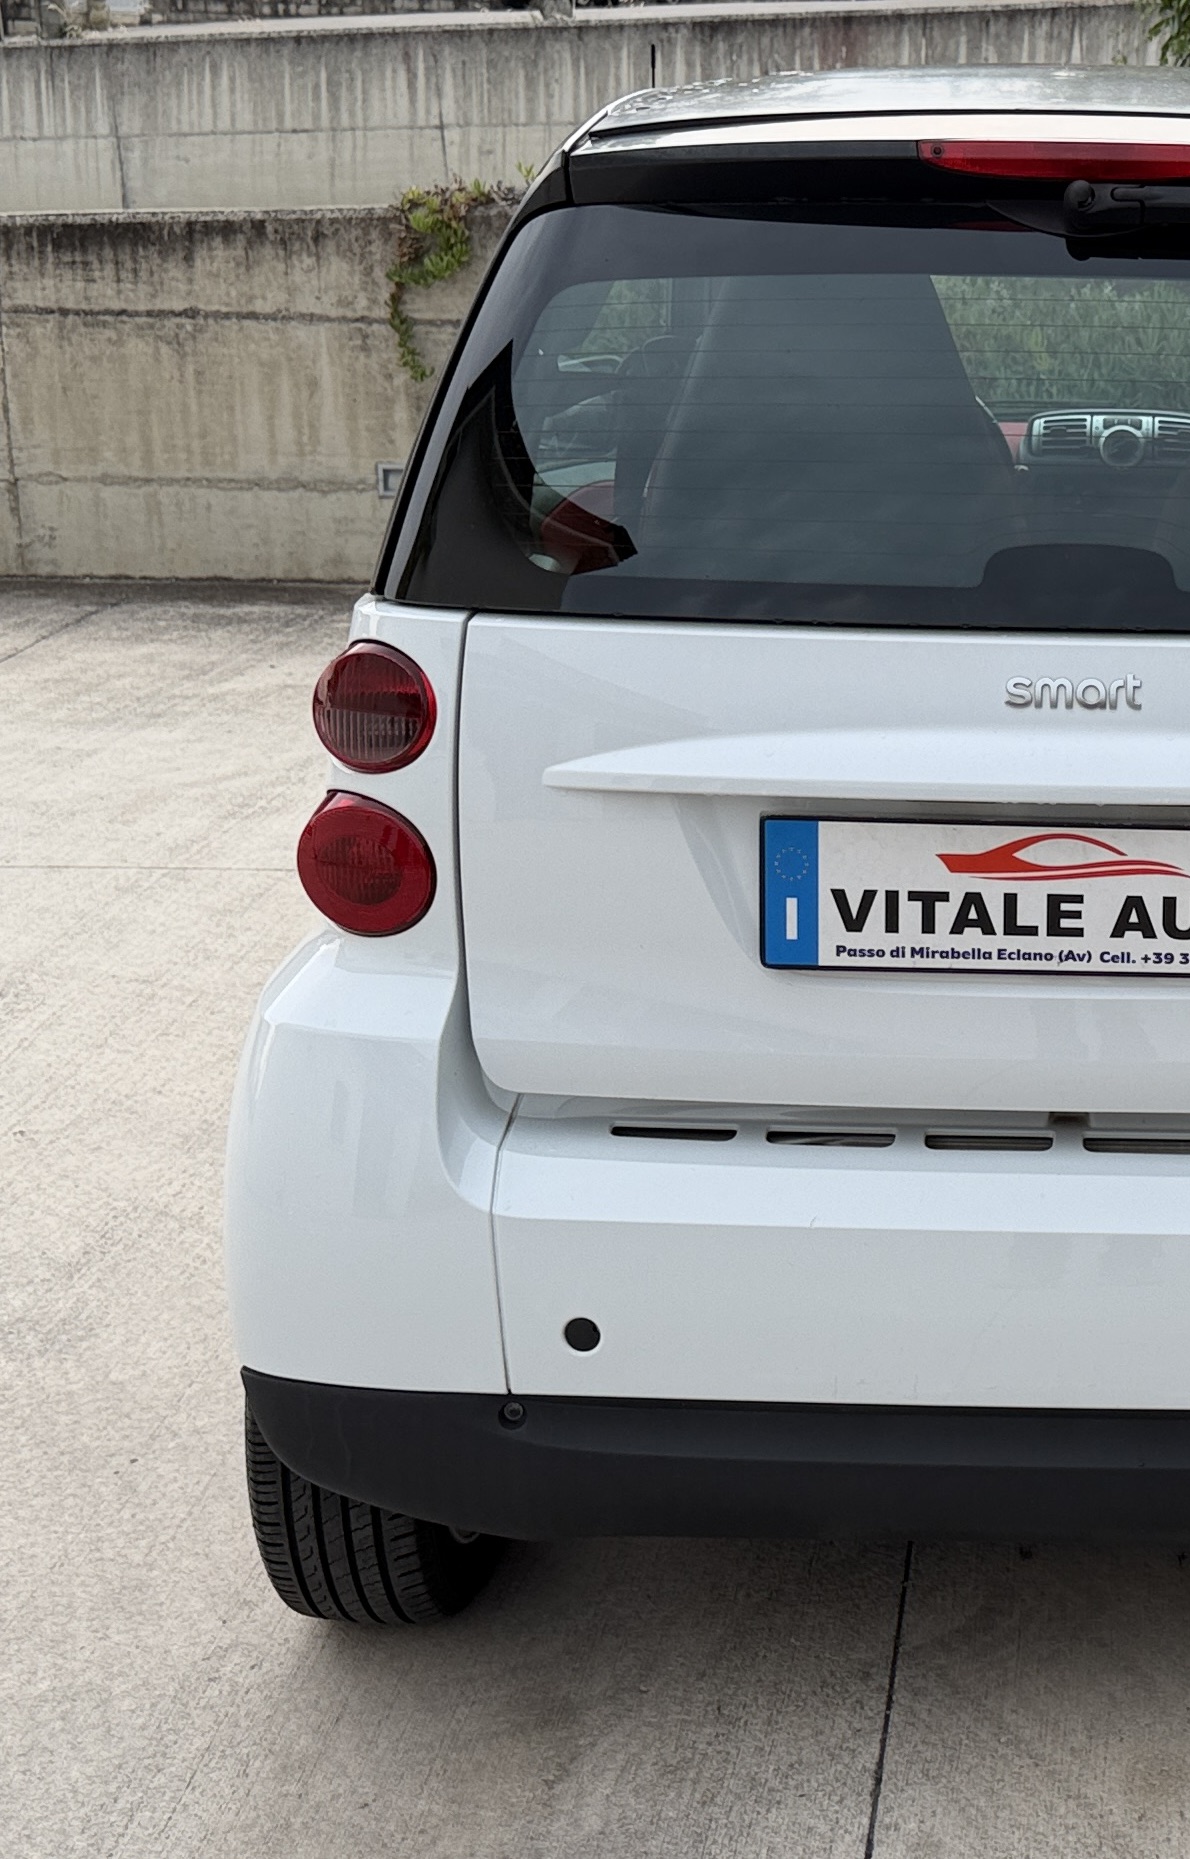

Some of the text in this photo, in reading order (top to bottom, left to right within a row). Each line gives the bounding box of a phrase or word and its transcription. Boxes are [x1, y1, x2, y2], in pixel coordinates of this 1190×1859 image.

[1004, 674, 1142, 711] smart
[785, 897, 798, 940] I
[830, 888, 1085, 938] VITALE
[835, 944, 886, 959] Passo
[889, 946, 906, 959] di
[910, 946, 993, 961] Mirabella
[997, 948, 1055, 962] Eclano
[1058, 949, 1093, 964] (Av)
[1099, 950, 1137, 964] Cell.
[1140, 951, 1175, 965] +39
